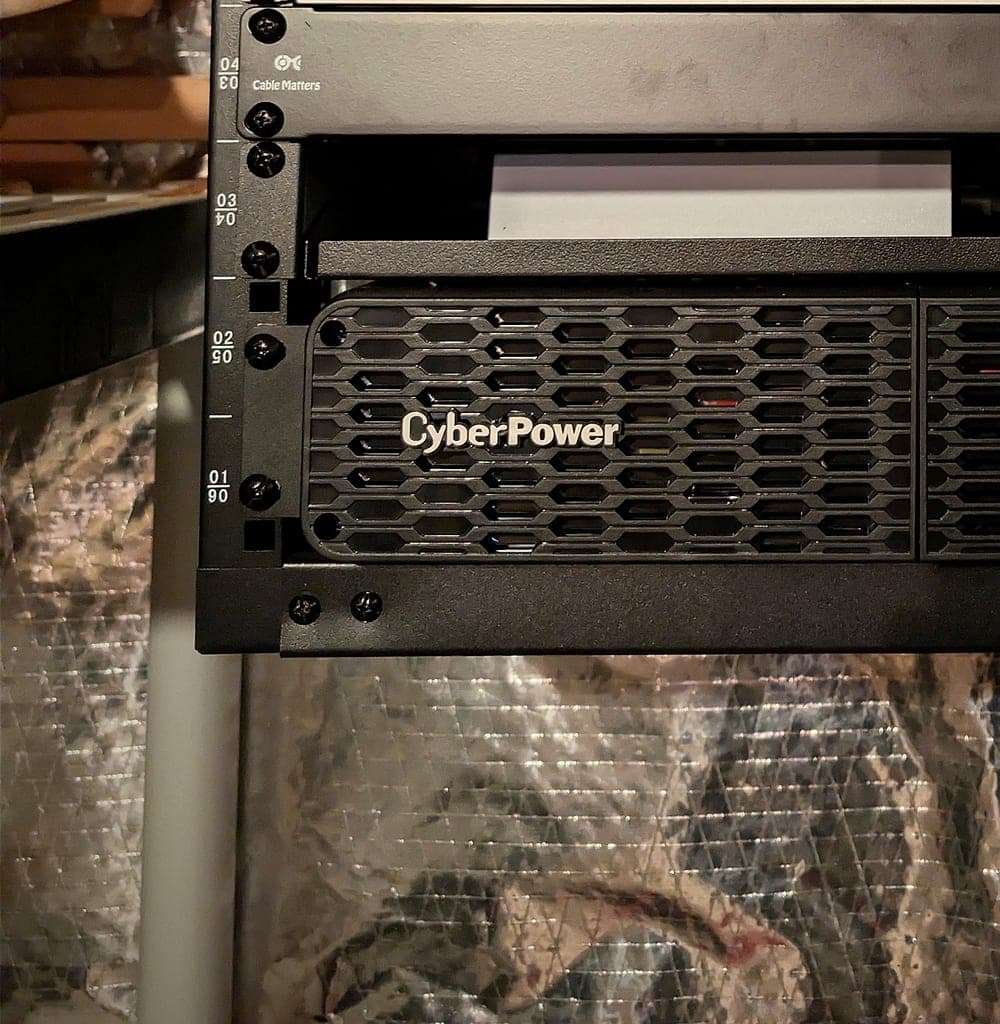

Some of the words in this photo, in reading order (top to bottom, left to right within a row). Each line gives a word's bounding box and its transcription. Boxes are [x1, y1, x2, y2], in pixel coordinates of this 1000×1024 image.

[220, 57, 239, 71] 04
[252, 79, 280, 91] Cable
[281, 79, 321, 91] Matters
[216, 193, 237, 207] 03
[212, 330, 234, 345] 02
[401, 411, 620, 455] CyberPower
[208, 469, 228, 484] 01
